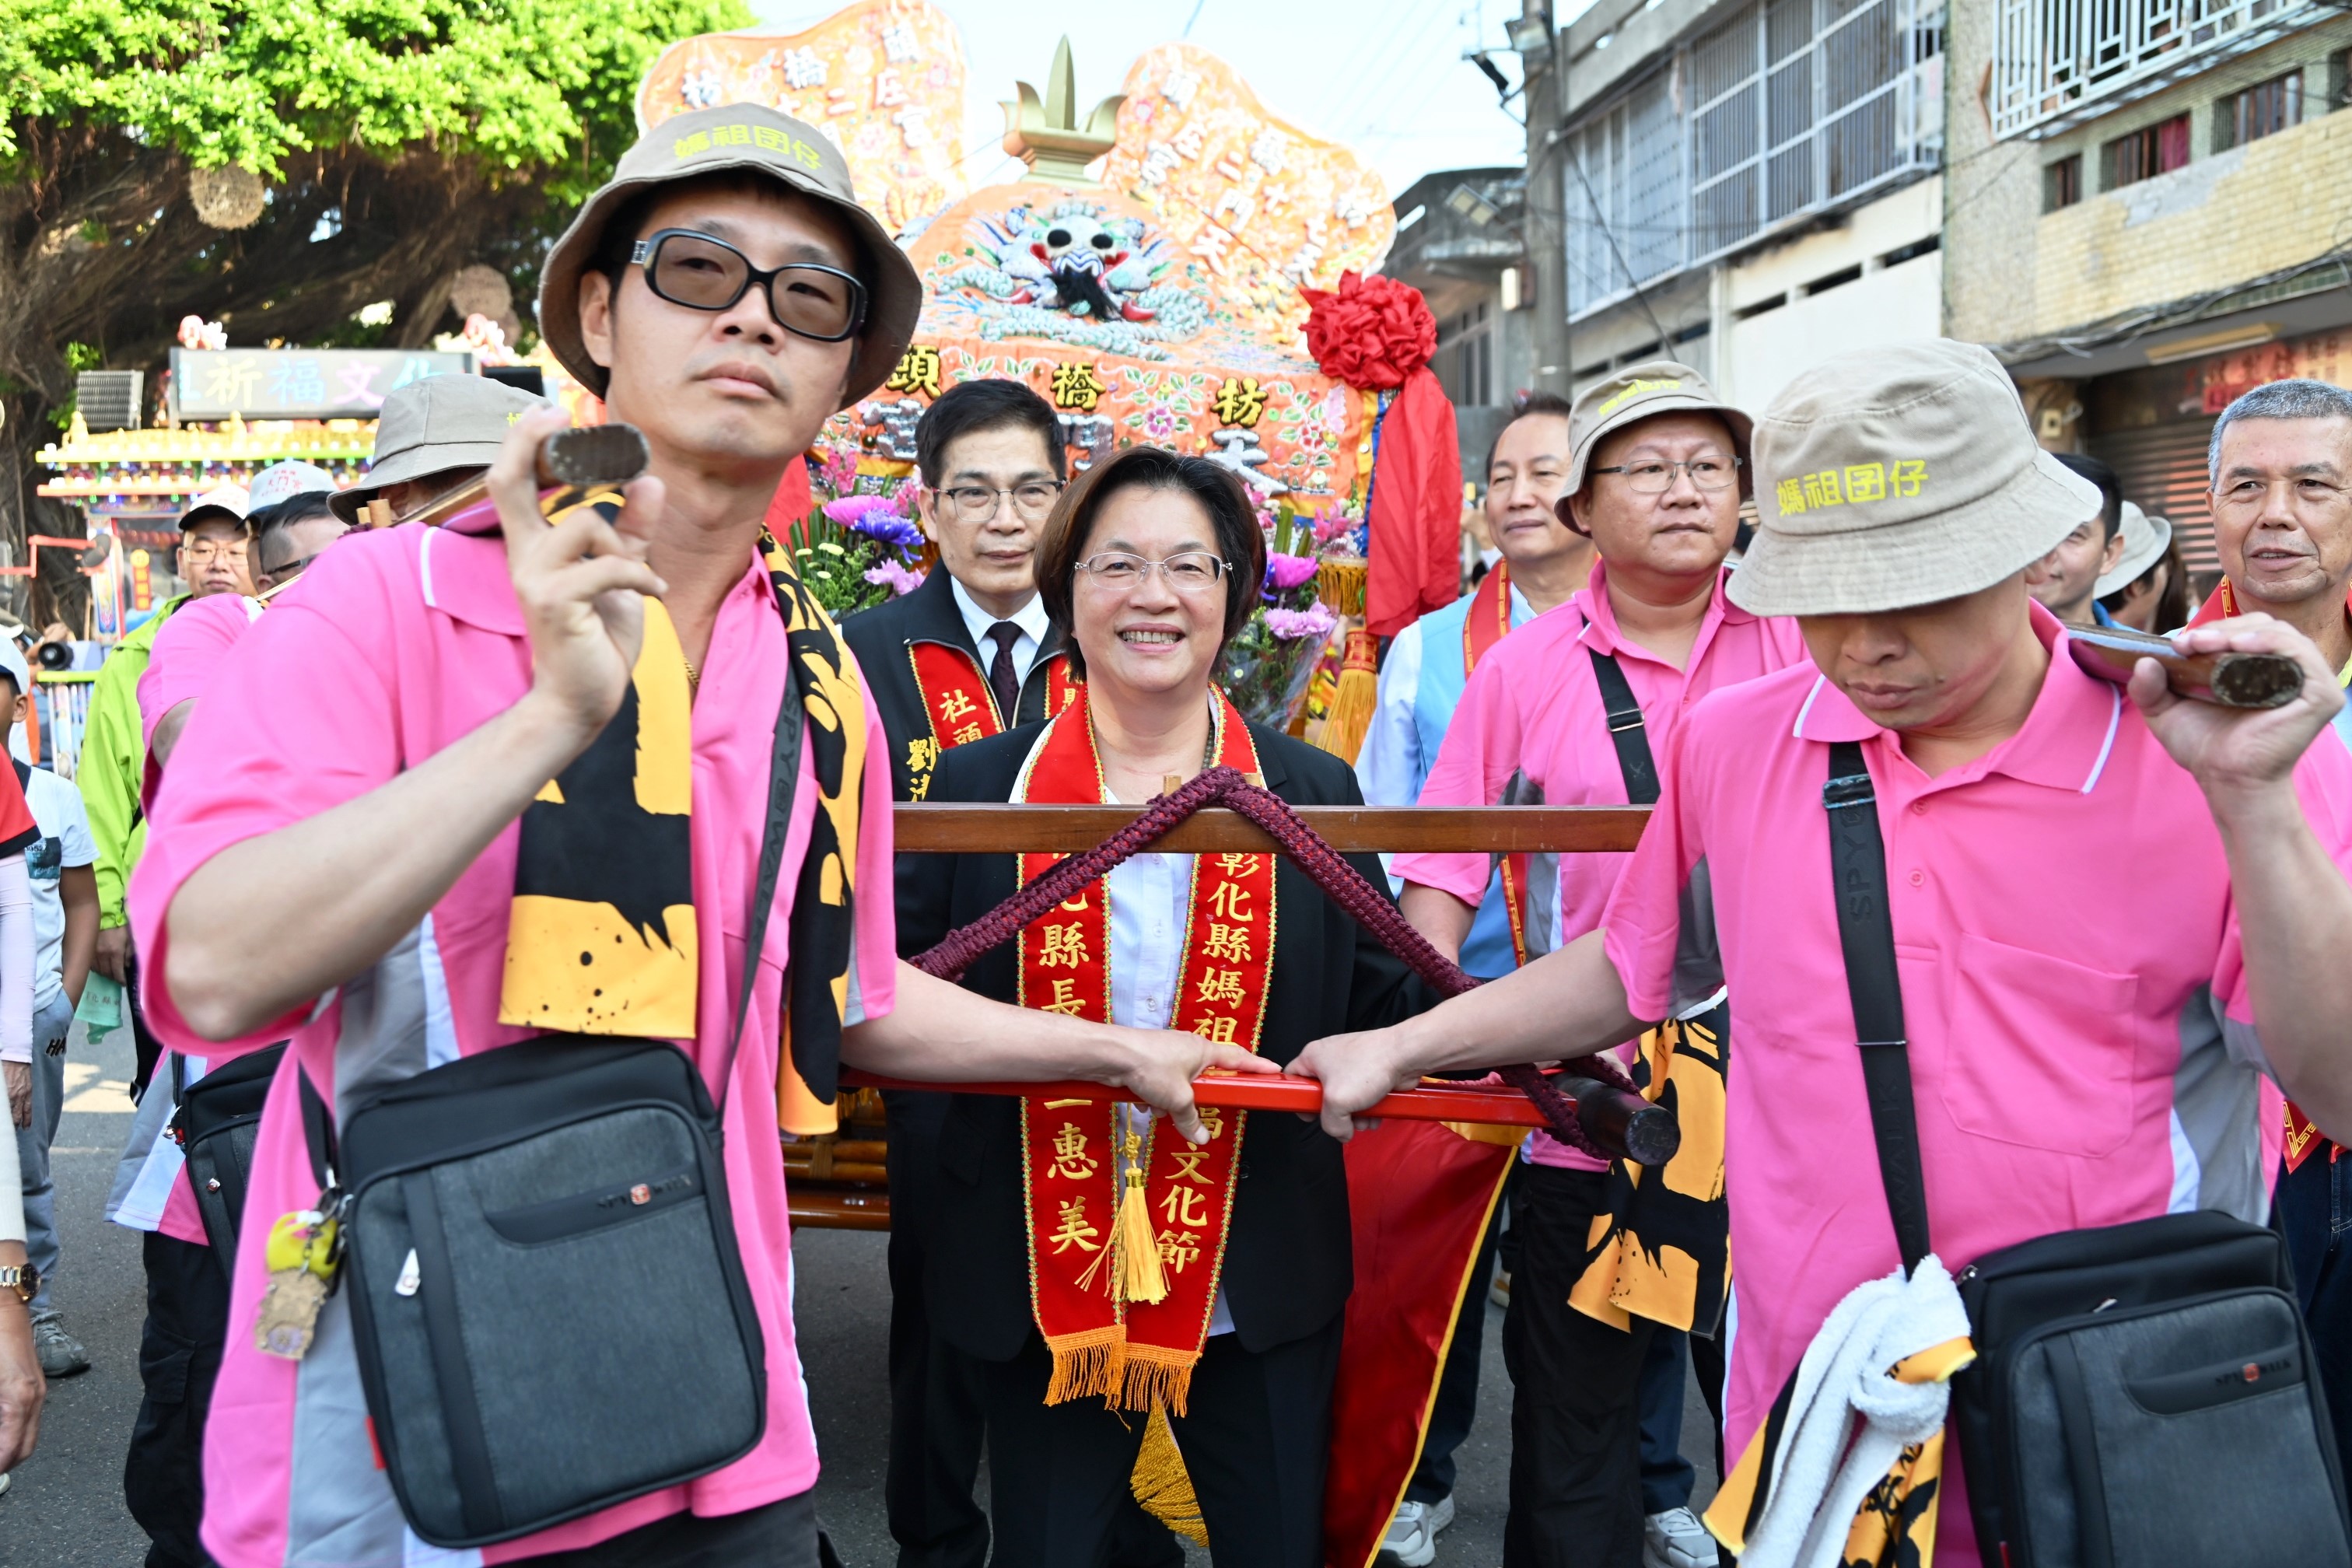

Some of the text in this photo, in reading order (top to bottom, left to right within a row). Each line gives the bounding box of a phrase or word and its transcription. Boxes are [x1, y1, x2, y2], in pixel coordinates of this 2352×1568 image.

[1776, 460, 1929, 516] 媽祖囝仔
[1840, 833, 1872, 924] SPY
